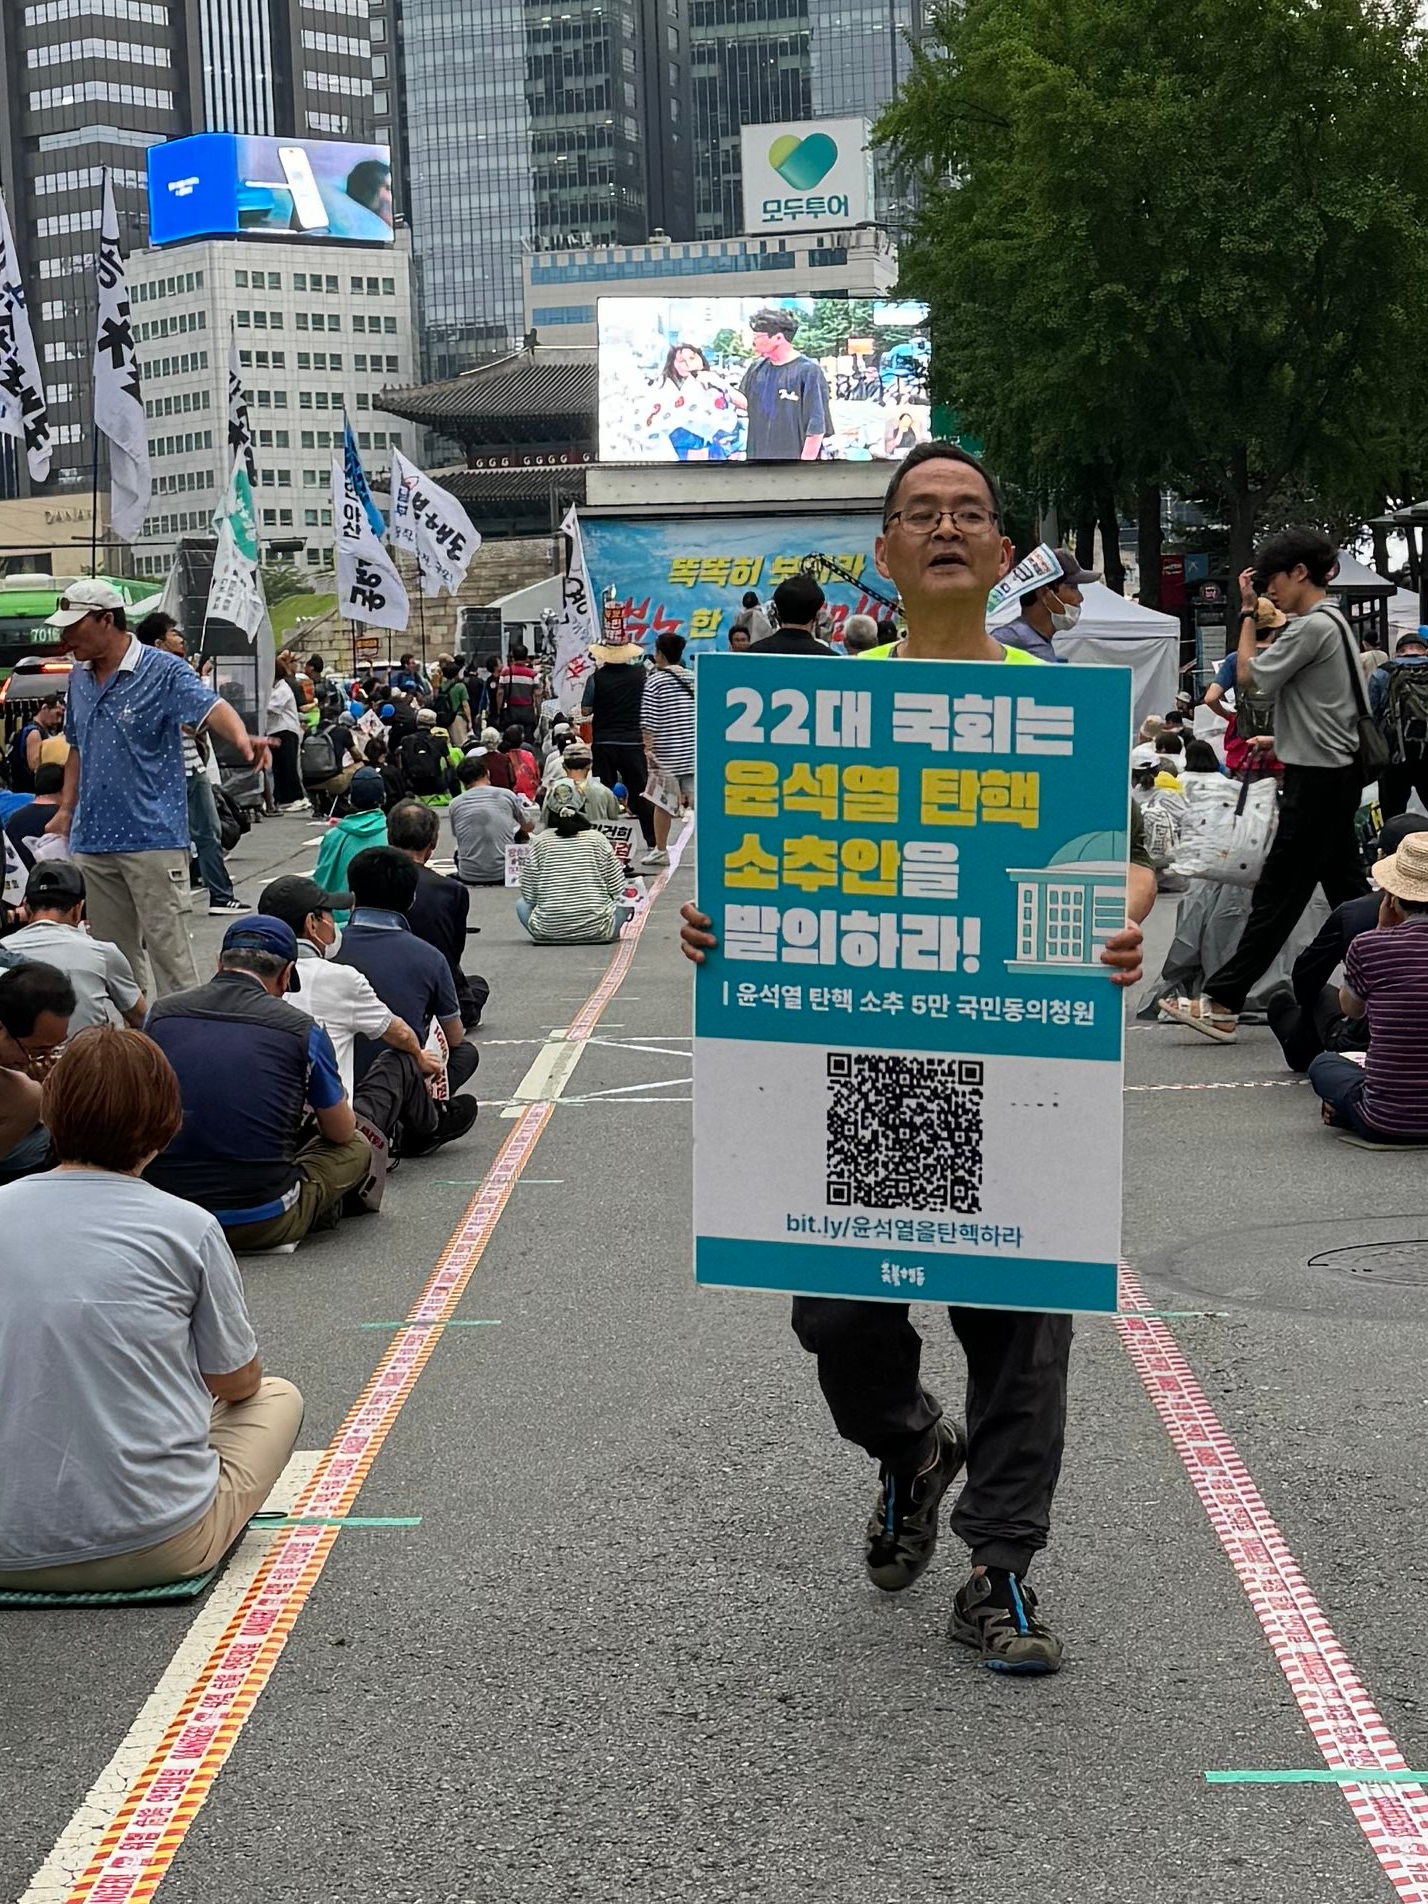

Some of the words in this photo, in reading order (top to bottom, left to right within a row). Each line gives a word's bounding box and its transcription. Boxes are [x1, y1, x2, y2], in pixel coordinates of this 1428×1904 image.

[761, 194, 850, 223] 모두투어
[668, 555, 766, 588] 똑똑히
[767, 552, 867, 588] 보라
[724, 686, 872, 750] 22대
[892, 690, 1075, 757] 국회는
[723, 759, 900, 823] 윤석열
[919, 767, 1041, 830] 탄핵
[723, 831, 960, 900] 소추안을
[723, 903, 982, 975] 발의하라!
[737, 982, 803, 1012] 윤석열
[808, 987, 854, 1014] 탄핵
[859, 990, 905, 1017] 소추
[911, 994, 951, 1020] 5만
[955, 996, 1096, 1027] 국민동의청원
[785, 1211, 1024, 1249] bit.ly/윤석열을탄핵하라
